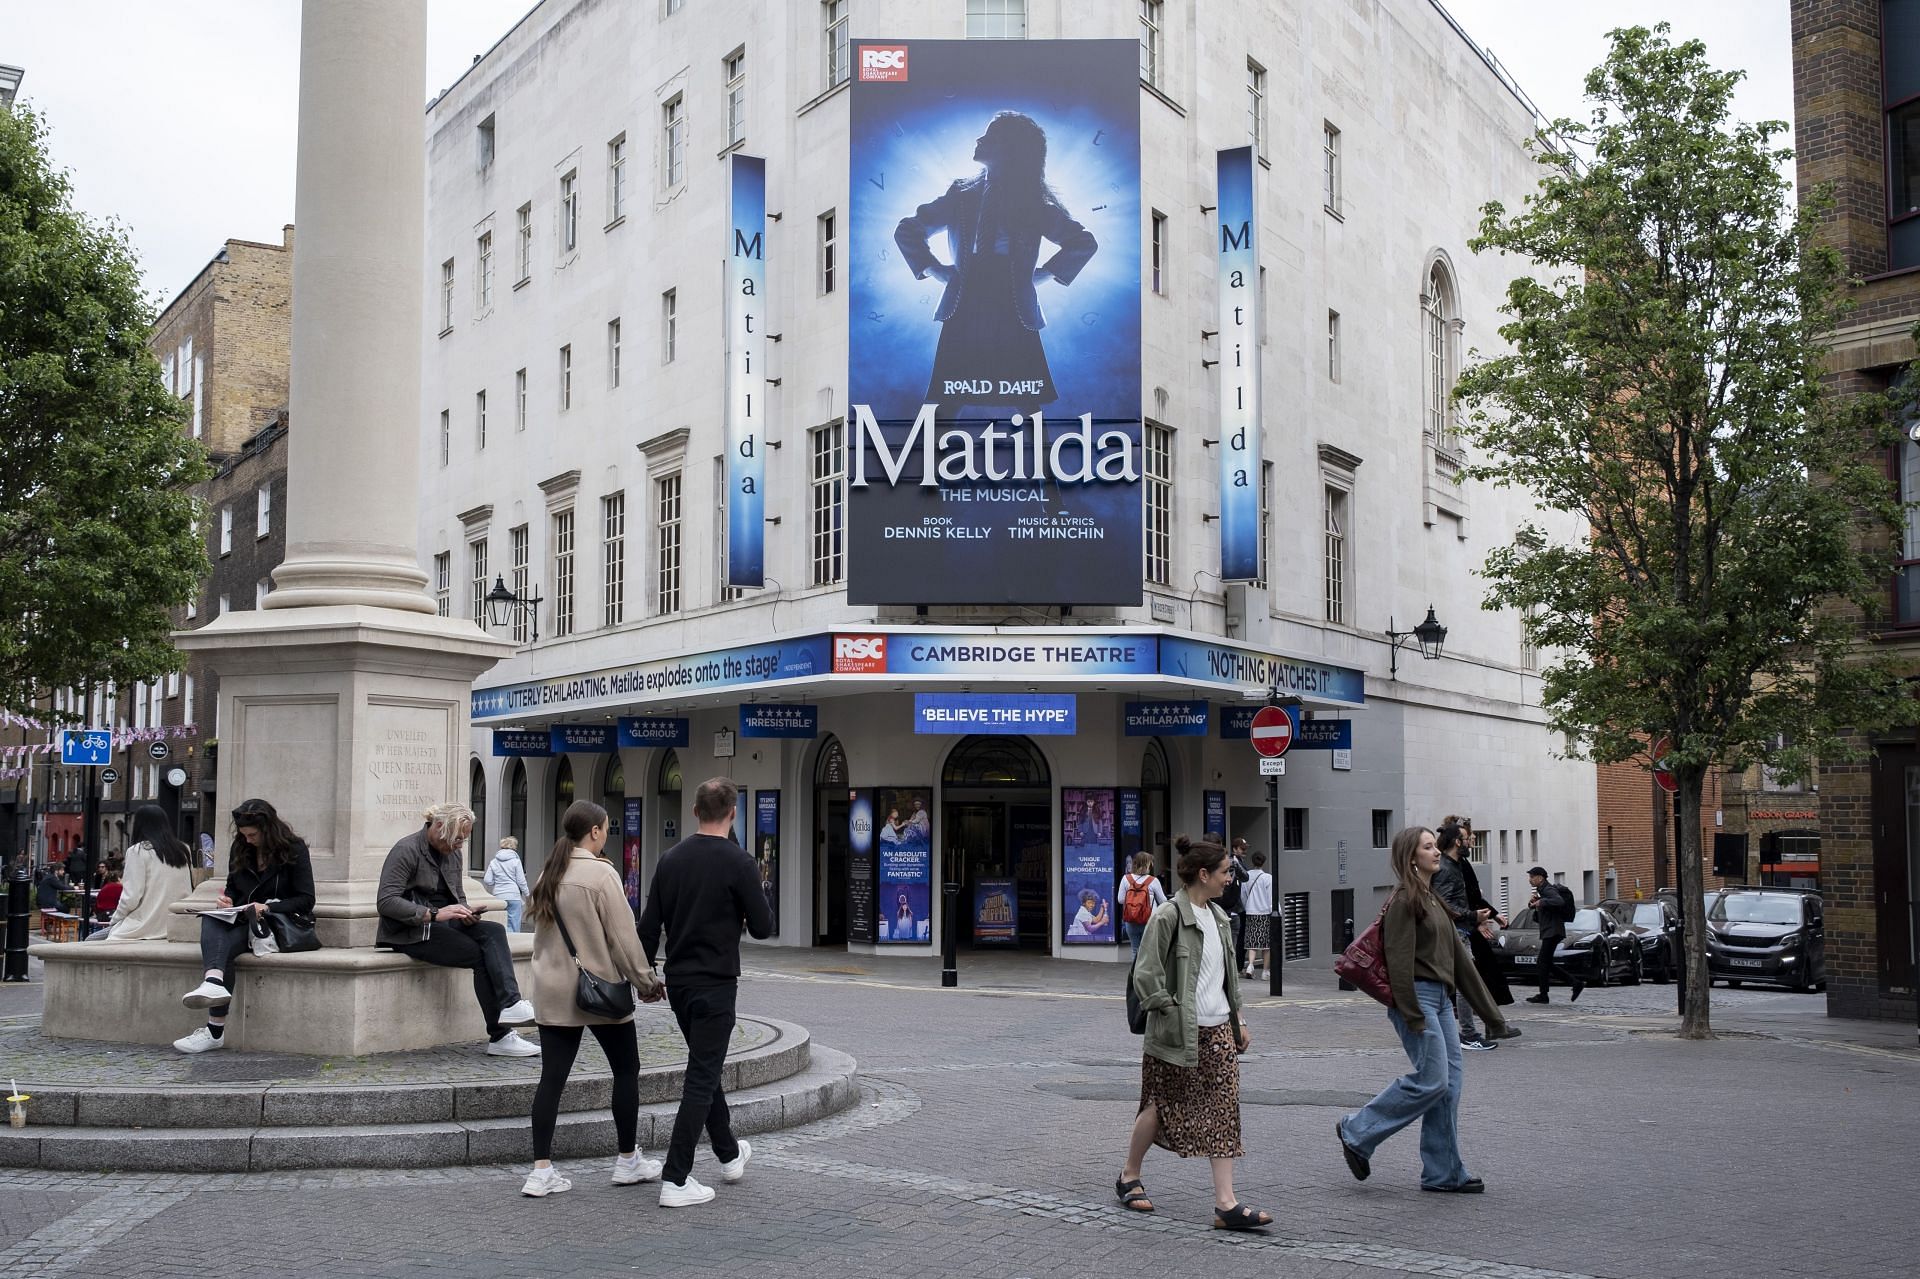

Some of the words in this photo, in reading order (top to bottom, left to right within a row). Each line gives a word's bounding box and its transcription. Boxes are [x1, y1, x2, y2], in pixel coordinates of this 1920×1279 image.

[862, 50, 905, 69] RSC
[734, 229, 762, 494] Matilda
[1221, 221, 1250, 488] Matilda
[943, 380, 993, 395] ROALD
[850, 403, 1141, 488] Matilda
[940, 488, 973, 502] THE
[976, 488, 1050, 502] MUSICAL
[923, 517, 953, 526] BOOK
[1018, 517, 1050, 526] MUSIC
[1051, 517, 1059, 526] &
[1061, 517, 1095, 526] LYRICS
[884, 527, 941, 539] DENNIS
[946, 527, 992, 539] KELLY
[1008, 527, 1034, 539] TIM
[1039, 527, 1105, 539] MINCHIN
[836, 638, 883, 659] RSC
[910, 646, 1036, 662] CAMBRIDGE
[1042, 646, 1136, 662] THEATRE
[543, 676, 608, 703] EXHILARATING.
[610, 671, 644, 695] Matilda
[647, 664, 692, 692] explodes
[695, 661, 721, 683] onto
[723, 656, 742, 680] the
[1268, 661, 1317, 692] MATCHES
[922, 708, 988, 721] 'BELIEVE
[992, 709, 1022, 721] THE
[1025, 709, 1069, 722] HYPE'
[368, 761, 402, 780] QUEEN
[405, 762, 442, 776] BEATRIX
[1262, 760, 1284, 768] Except
[1749, 810, 1781, 819] LONDON
